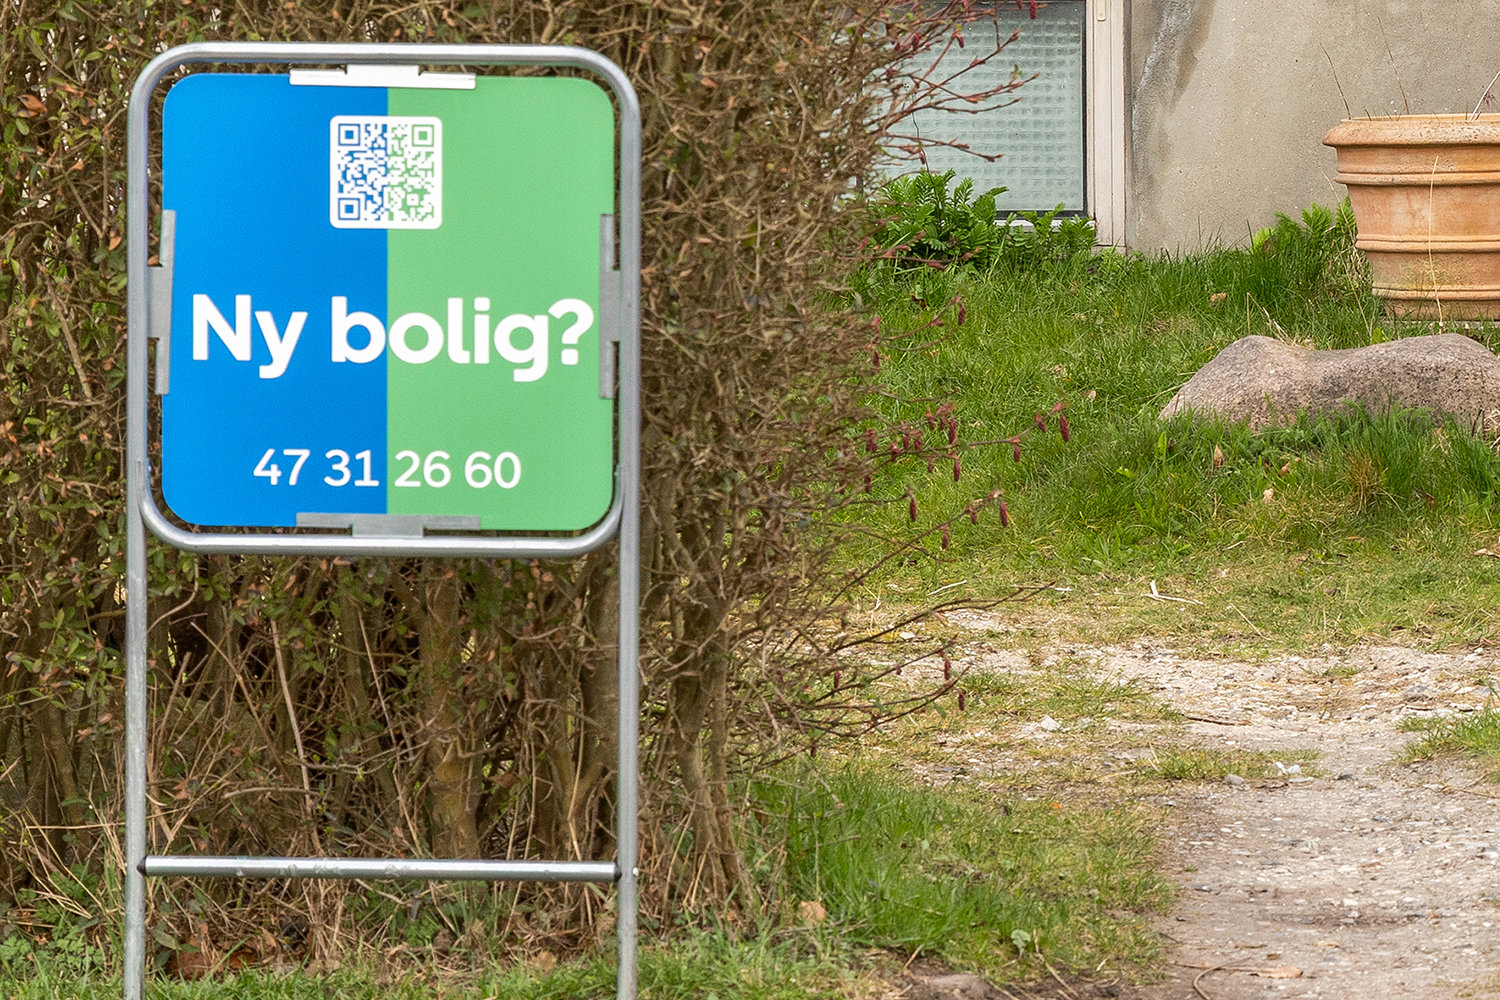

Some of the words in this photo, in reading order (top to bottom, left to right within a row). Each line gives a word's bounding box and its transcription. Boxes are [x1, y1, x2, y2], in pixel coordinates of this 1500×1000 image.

[193, 294, 308, 379] Ny
[331, 295, 595, 383] bolig?
[253, 448, 310, 486] 47
[324, 449, 379, 487] 31
[393, 449, 452, 489] 26
[463, 450, 523, 489] 60
